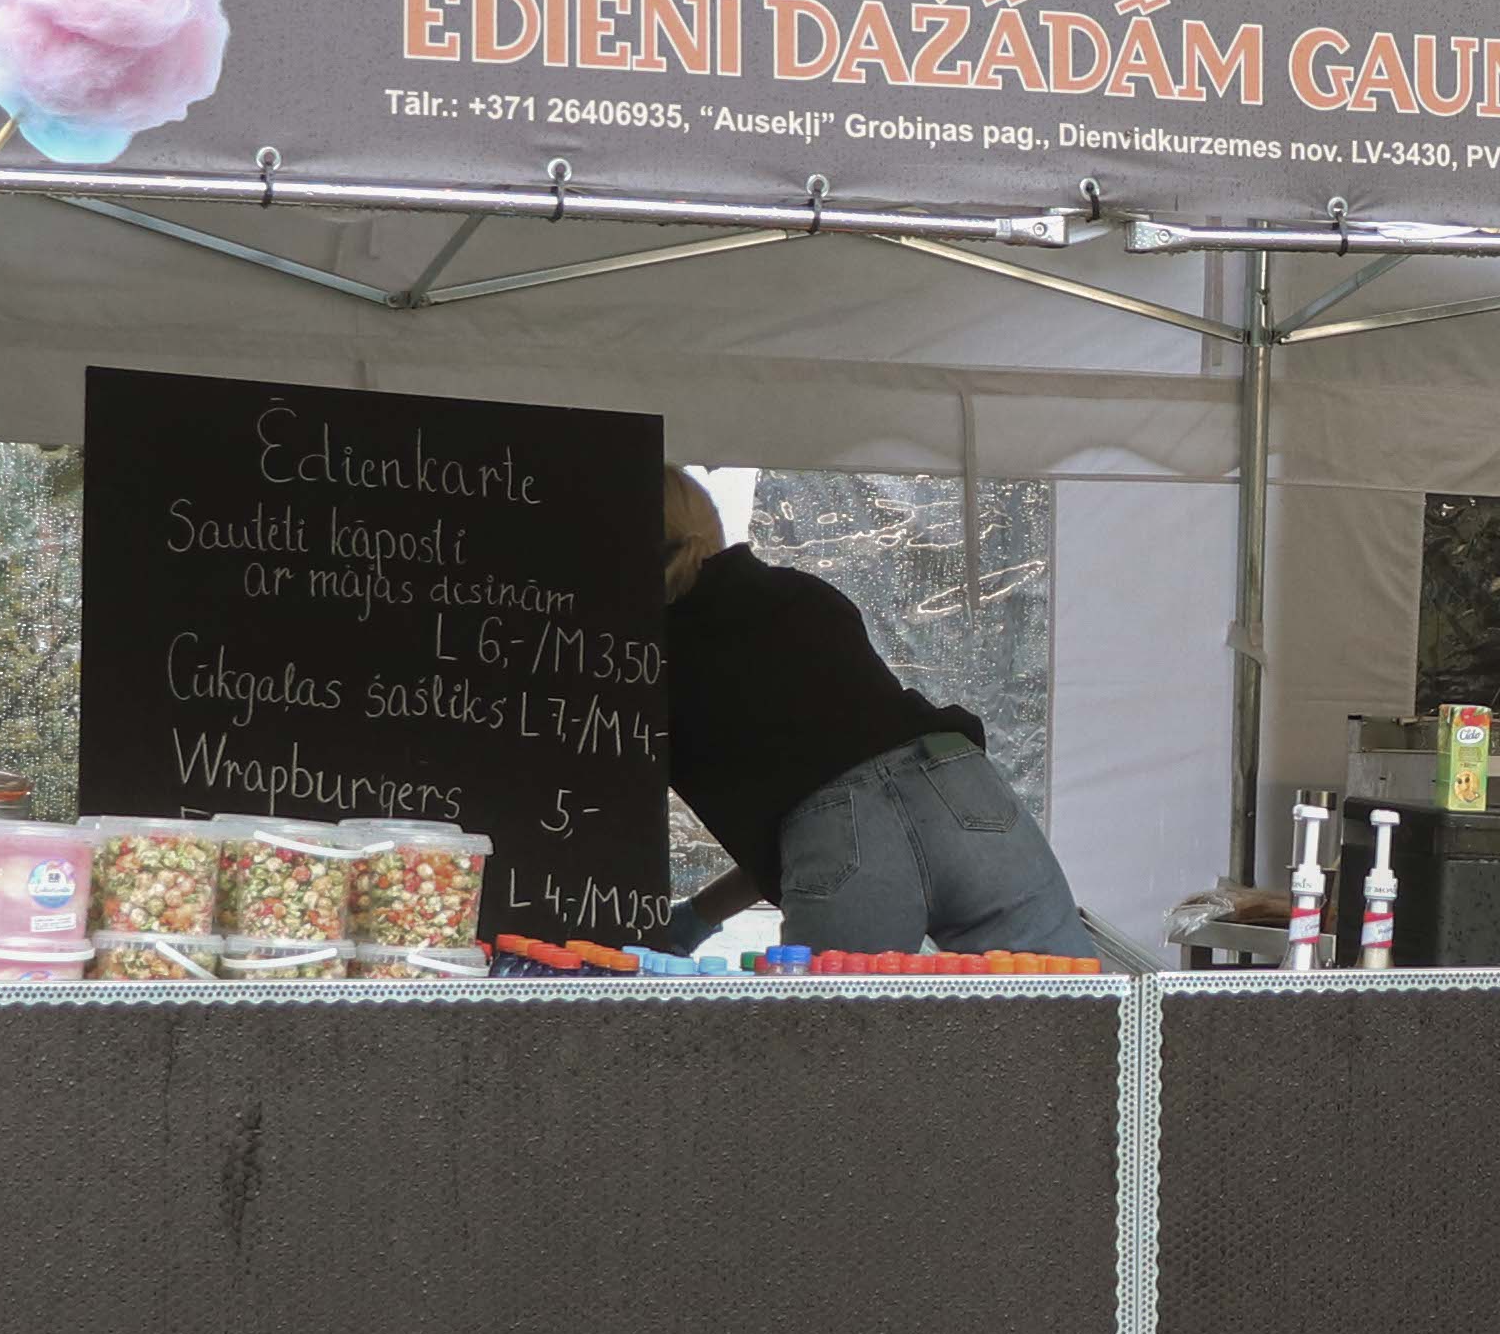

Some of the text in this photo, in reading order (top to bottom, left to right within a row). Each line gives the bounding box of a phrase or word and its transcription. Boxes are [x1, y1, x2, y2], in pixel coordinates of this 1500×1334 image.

[385, 89, 459, 119] Tālr.:
[469, 96, 536, 122] +371
[547, 99, 691, 133] 26406935,
[845, 115, 975, 150] Grobiņas
[983, 126, 1050, 151] pag.,
[1059, 123, 1283, 159] Dienvidkurzemes
[1291, 141, 1343, 163] nov.
[1352, 140, 1458, 171] LV-3430,
[257, 397, 541, 505] Ēdienkarte
[167, 498, 467, 575] Sautēti kāposti
[244, 562, 295, 598] ar
[436, 613, 457, 660] L
[167, 632, 342, 727] Cūkgaļas
[521, 691, 540, 737] L
[173, 727, 460, 819] Wrapburgers
[509, 867, 531, 908] L
